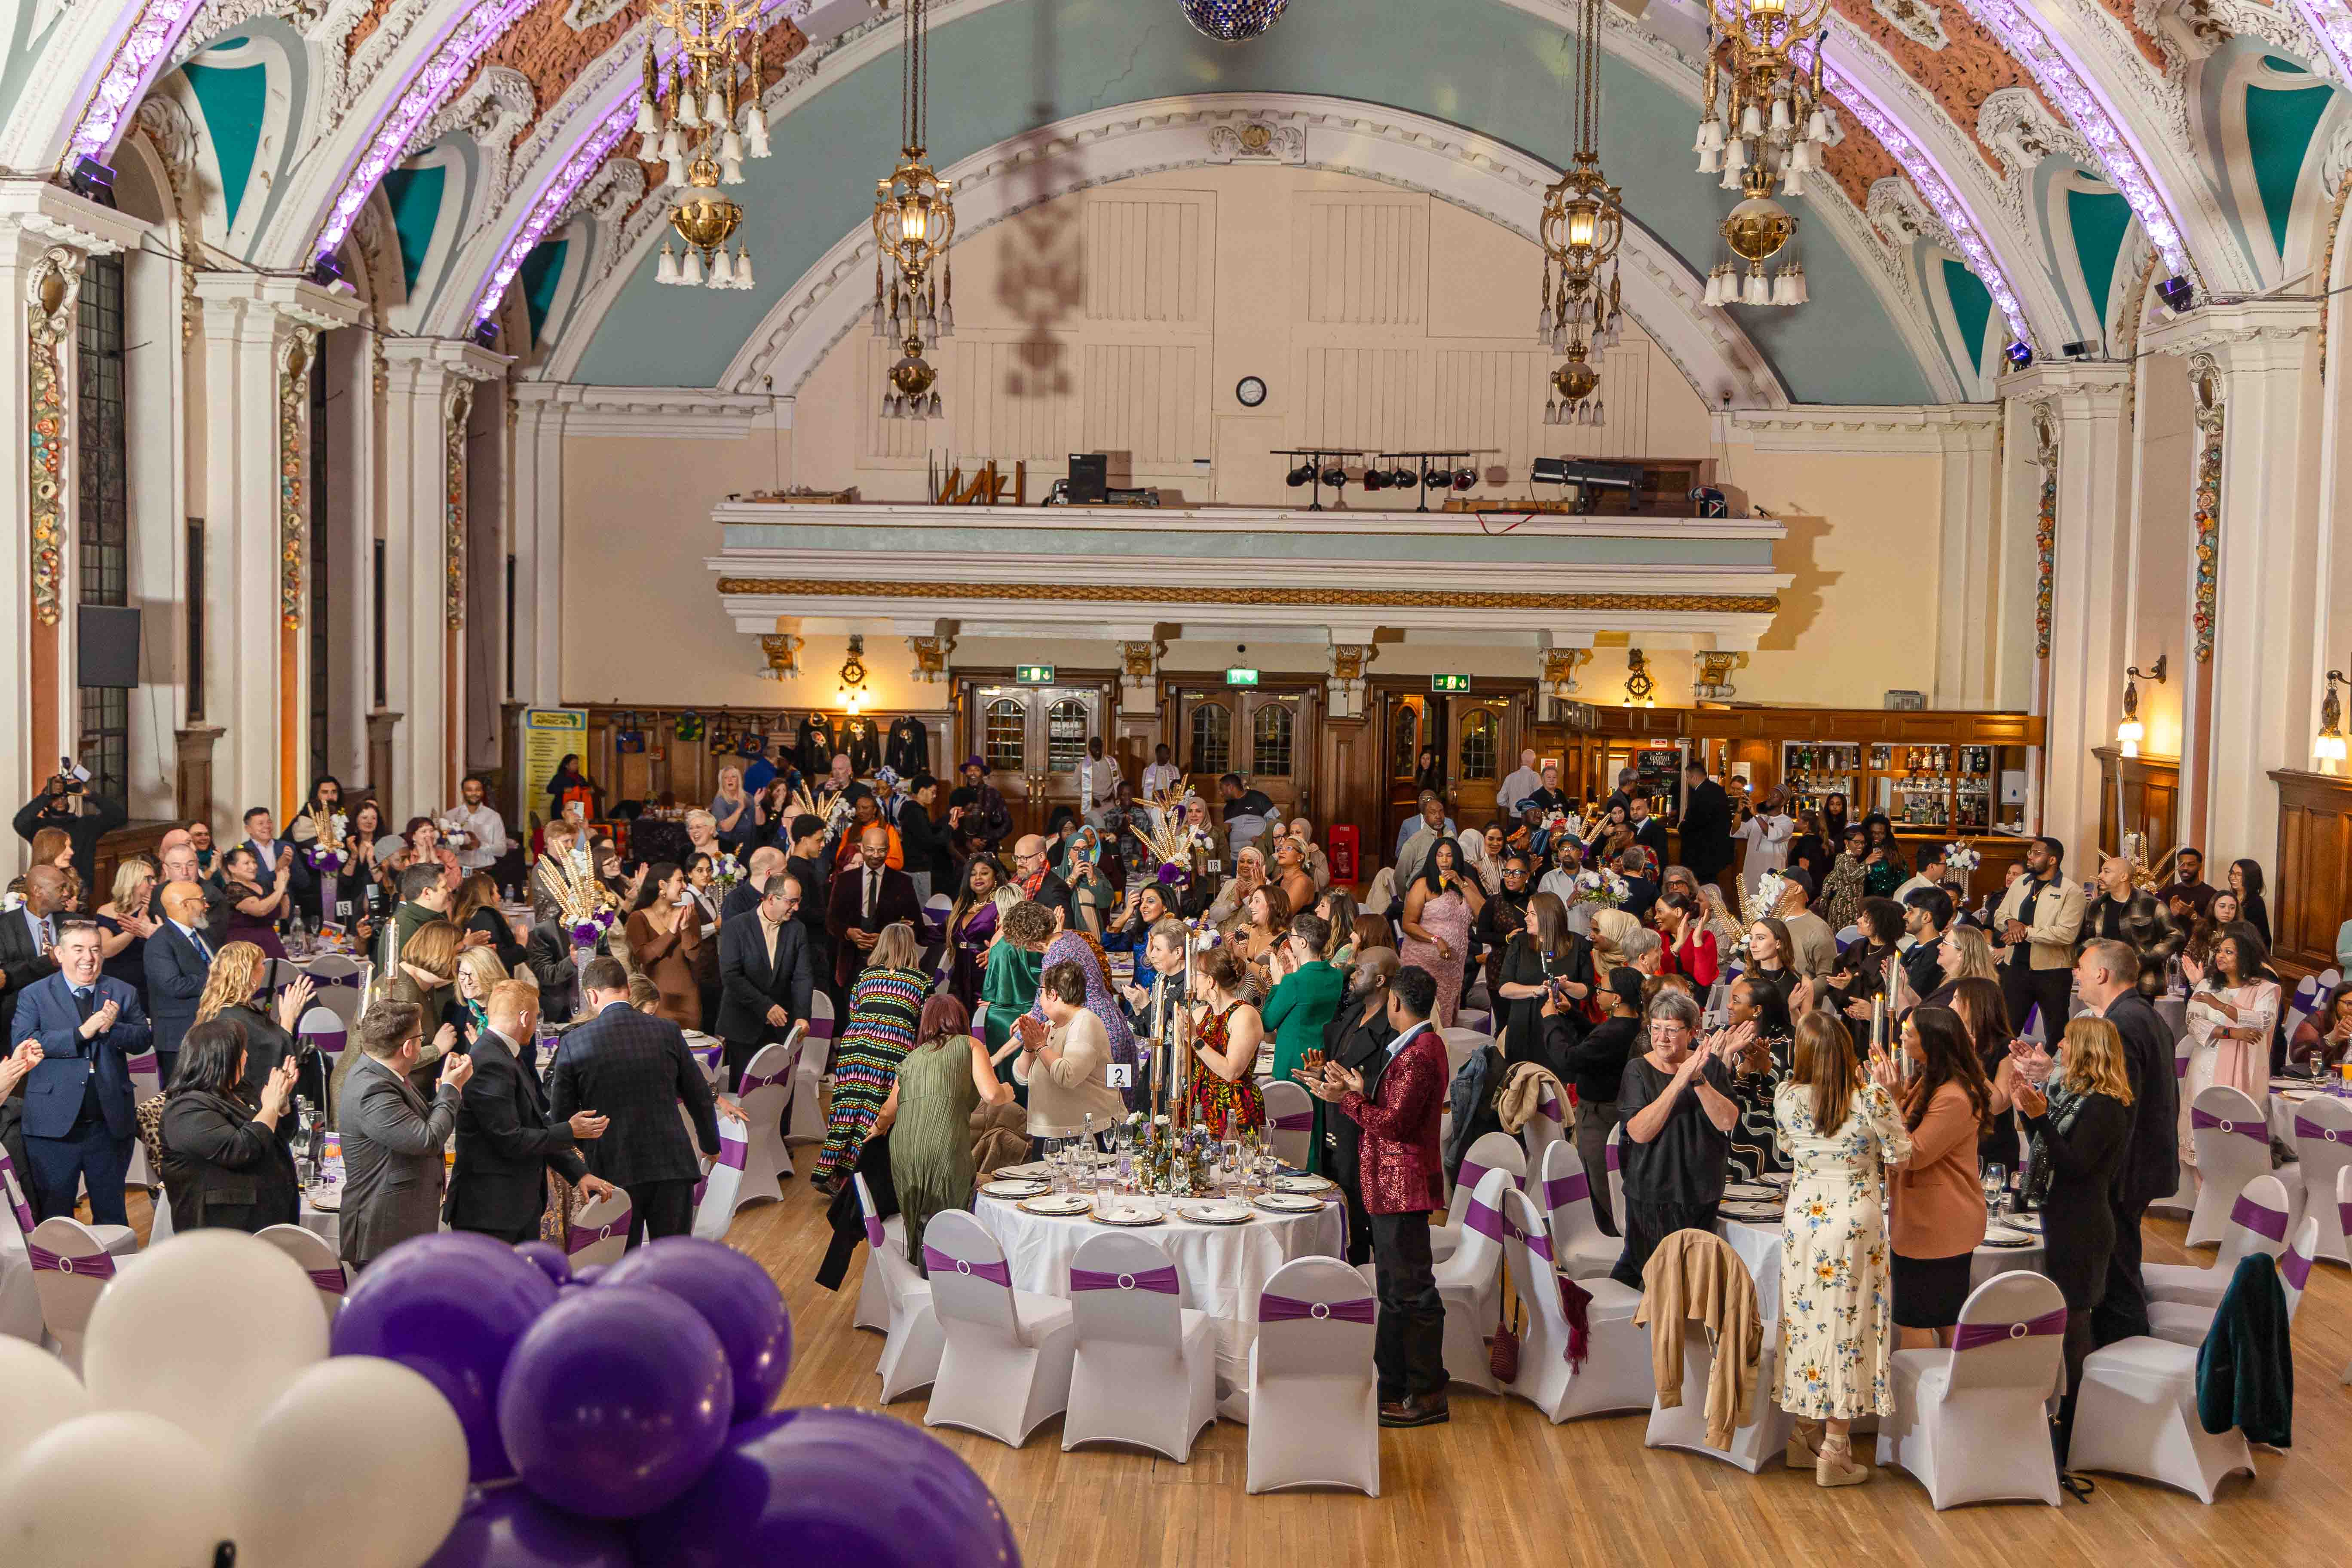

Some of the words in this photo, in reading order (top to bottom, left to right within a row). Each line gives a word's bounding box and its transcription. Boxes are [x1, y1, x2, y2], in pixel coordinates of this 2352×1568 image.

[1210, 861, 1218, 870] 18
[340, 903, 349, 915] 15
[1708, 1014, 1715, 1027] 7
[1114, 1068, 1123, 1083] 2
